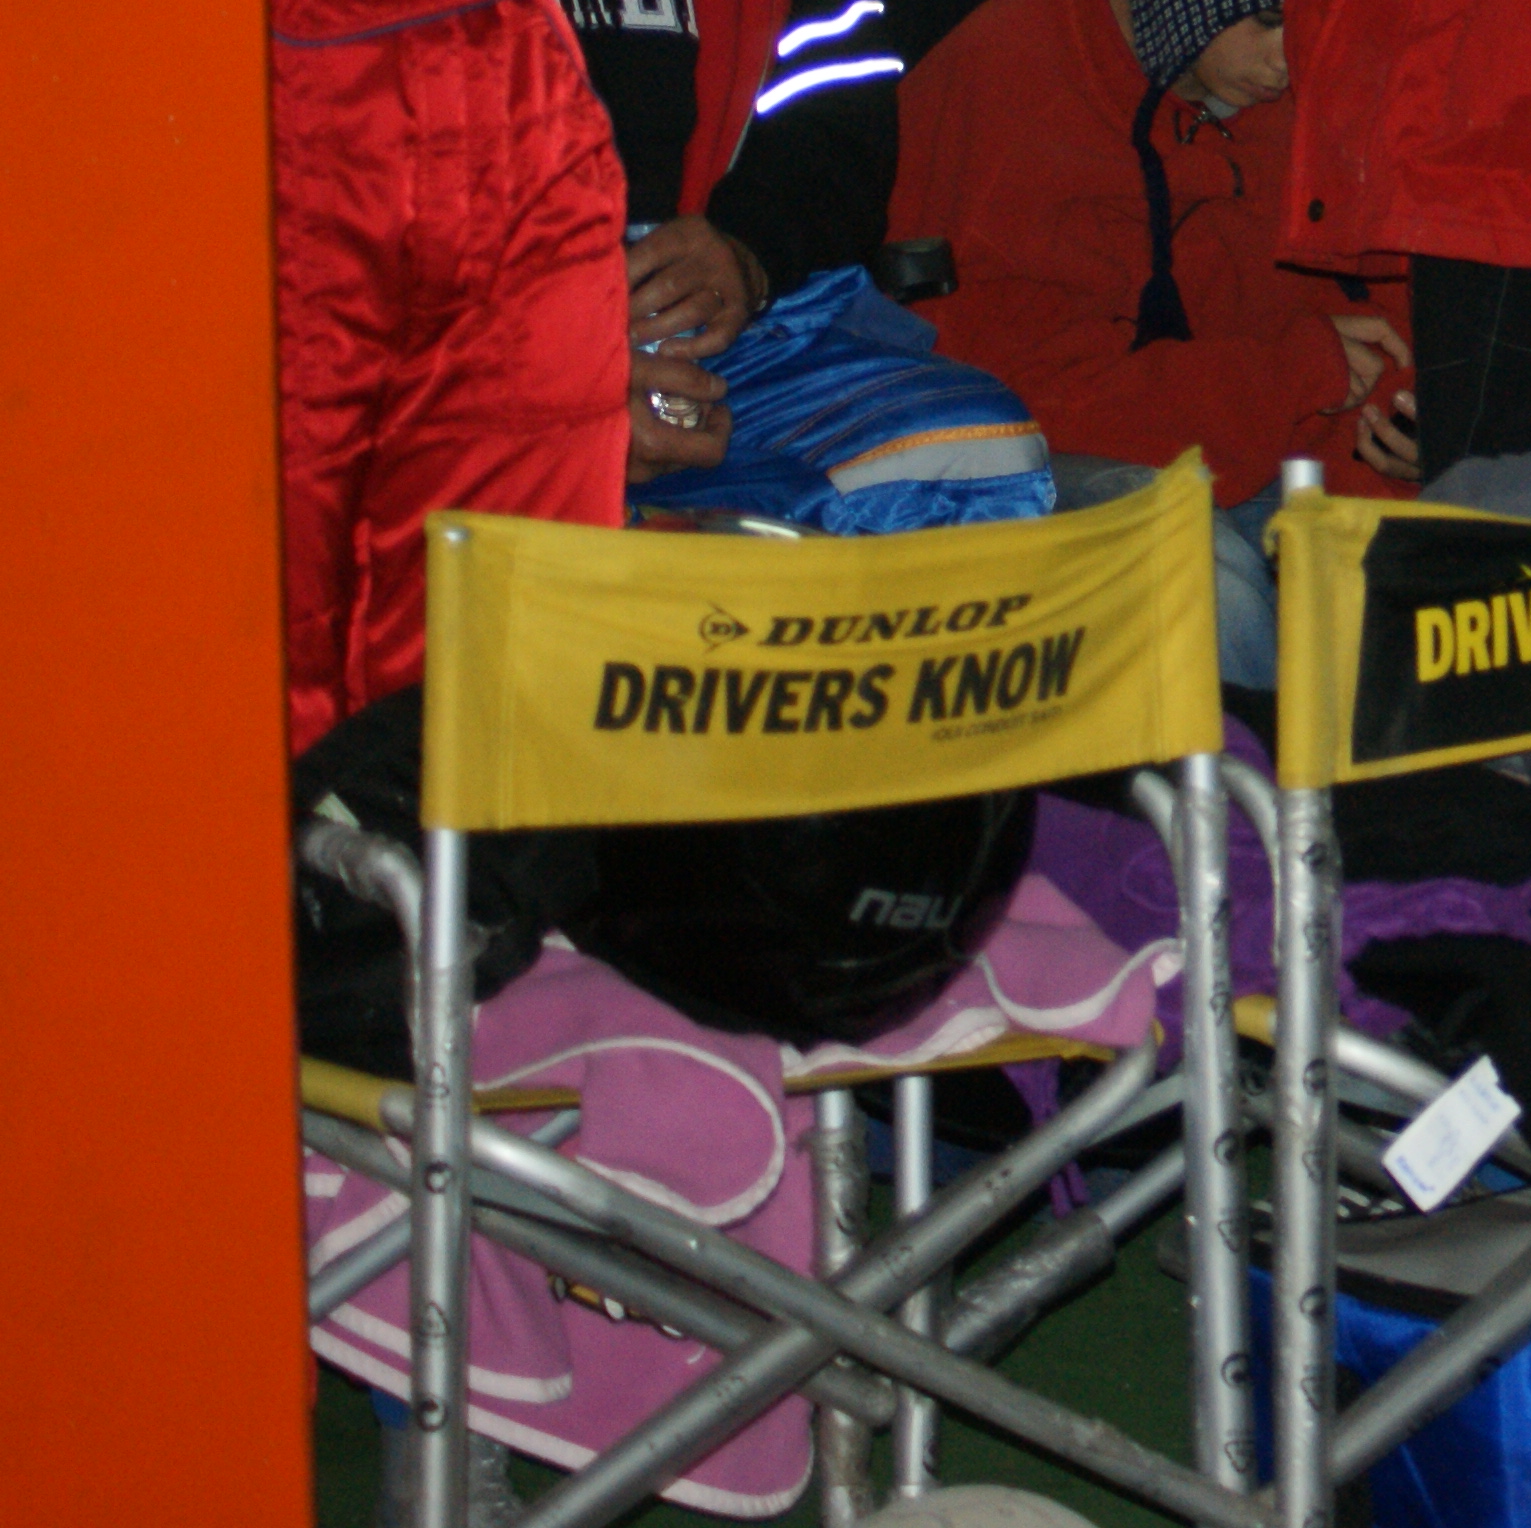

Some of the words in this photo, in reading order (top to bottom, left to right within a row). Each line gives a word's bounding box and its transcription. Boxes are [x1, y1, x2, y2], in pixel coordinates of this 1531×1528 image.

[758, 594, 1032, 647] DUNLOP
[594, 662, 895, 735] DRIVERS
[907, 626, 1085, 724] KNOW
